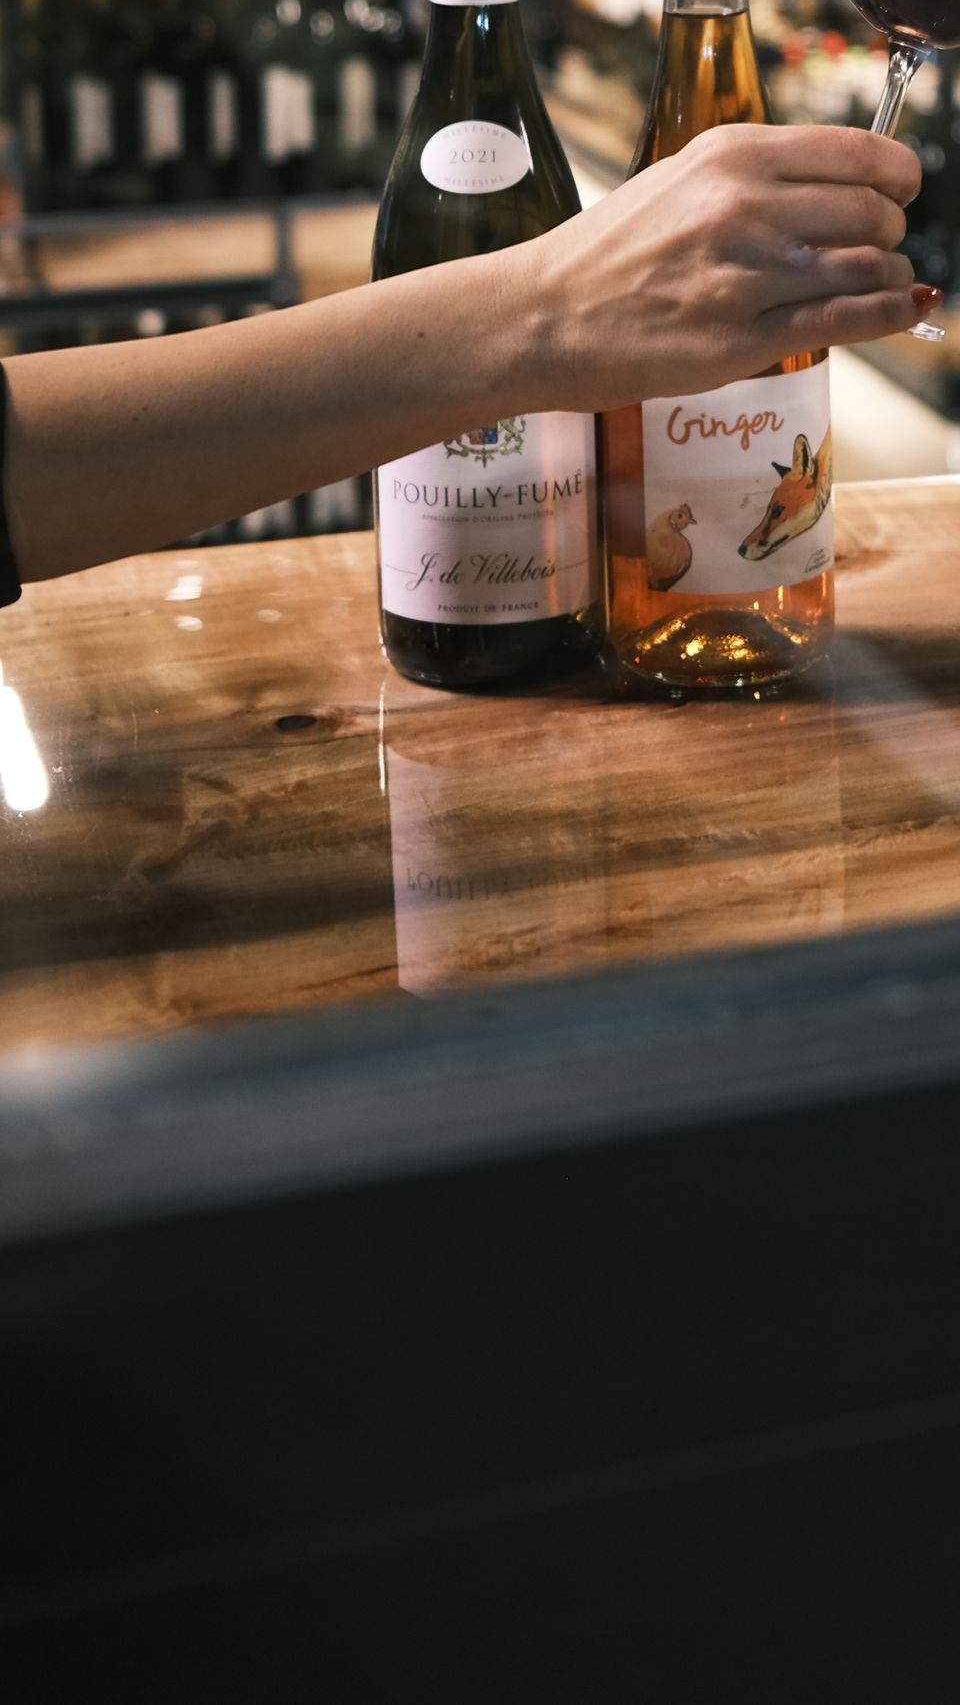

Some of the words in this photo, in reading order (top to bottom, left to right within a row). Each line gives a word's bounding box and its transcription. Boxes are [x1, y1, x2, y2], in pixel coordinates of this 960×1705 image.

[449, 149, 496, 165] 2021
[667, 406, 784, 451] Ginger
[439, 561, 463, 584] de
[470, 552, 556, 585] Villebois
[501, 601, 539, 612] FRANCE
